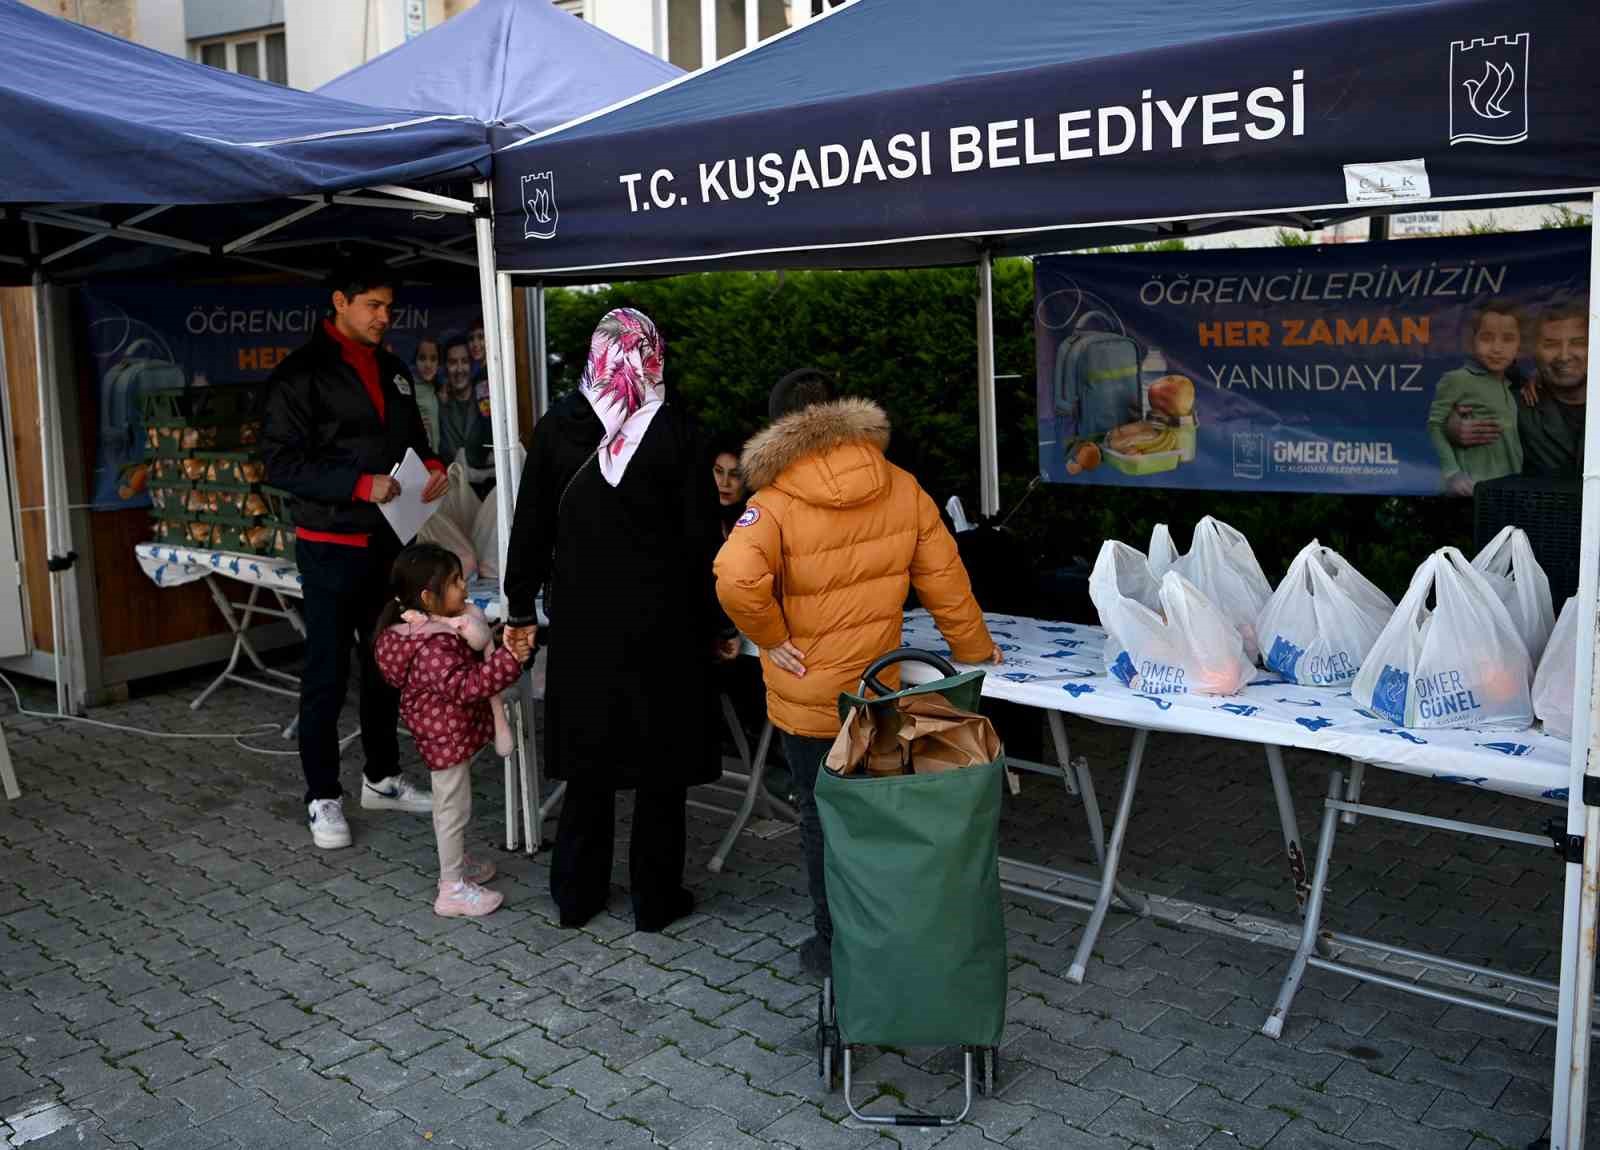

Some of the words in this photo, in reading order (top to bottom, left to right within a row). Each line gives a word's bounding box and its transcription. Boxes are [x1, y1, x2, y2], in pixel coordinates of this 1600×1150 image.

[620, 169, 687, 212] T.C.
[699, 131, 931, 206] KUŞADASI
[950, 69, 1305, 173] BELEDİYESİ
[1140, 260, 1507, 305] ÖĞRENCİLERİMİZİN
[1198, 320, 1271, 348] HER
[1281, 315, 1432, 347] ZAMAN
[1207, 363, 1424, 392] YANINDAYIZ
[1332, 441, 1399, 465] GÜNEL
[1419, 690, 1481, 720] GÜNEL
